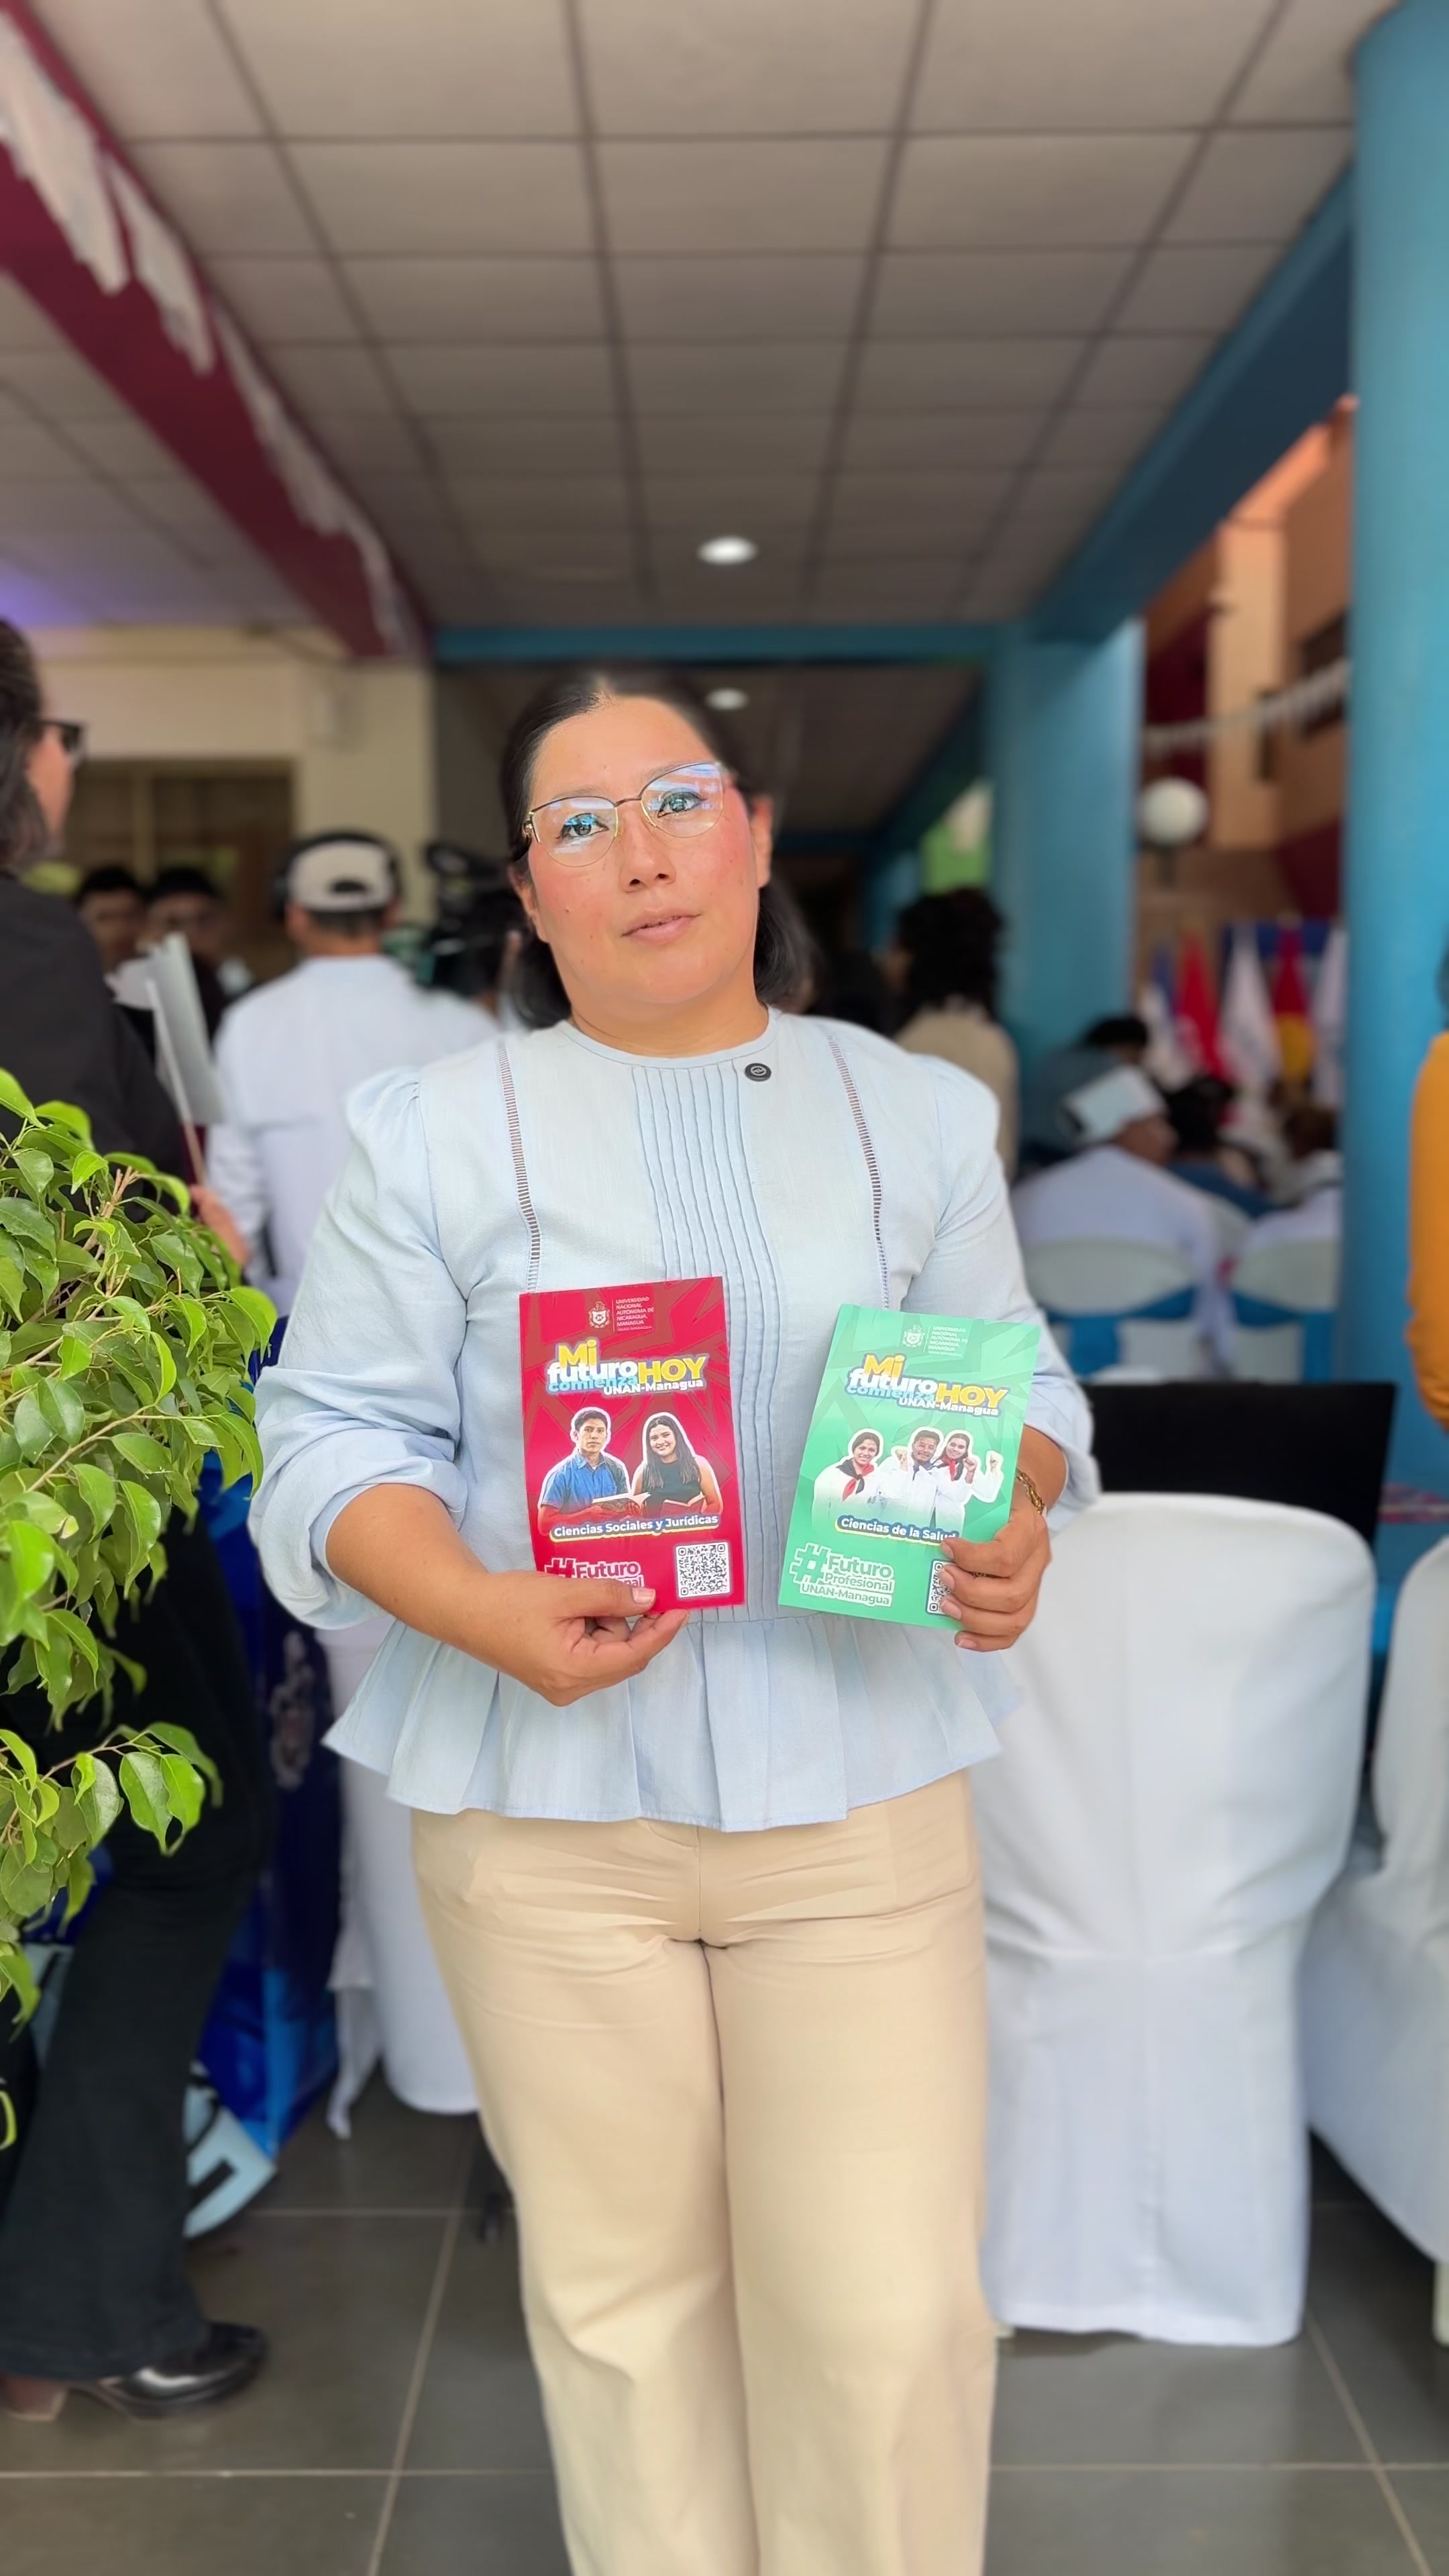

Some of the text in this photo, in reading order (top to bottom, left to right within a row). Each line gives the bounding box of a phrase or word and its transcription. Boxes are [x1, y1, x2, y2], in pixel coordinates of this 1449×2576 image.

[615, 1296, 650, 1304] UNIVERSIDAD
[558, 1340, 597, 1368] Mi
[547, 1356, 708, 1384] futuro HOY
[863, 1354, 905, 1381] Mi
[548, 1375, 638, 1392] comienza
[604, 1379, 704, 1395] UNAN-Managua
[847, 1385, 936, 1401] comienza
[849, 1368, 1008, 1408] futuro HOY
[899, 1397, 999, 1416] UNAN-Managua
[554, 1514, 718, 1537] Ciencias Sociales y Jurídicas
[841, 1517, 890, 1534] Ciencias
[892, 1525, 907, 1536] de
[909, 1527, 920, 1538] la
[789, 1542, 894, 1585] #Futuro
[824, 1572, 893, 1592] Profesional
[801, 1582, 890, 1605] UNAN-Managua
